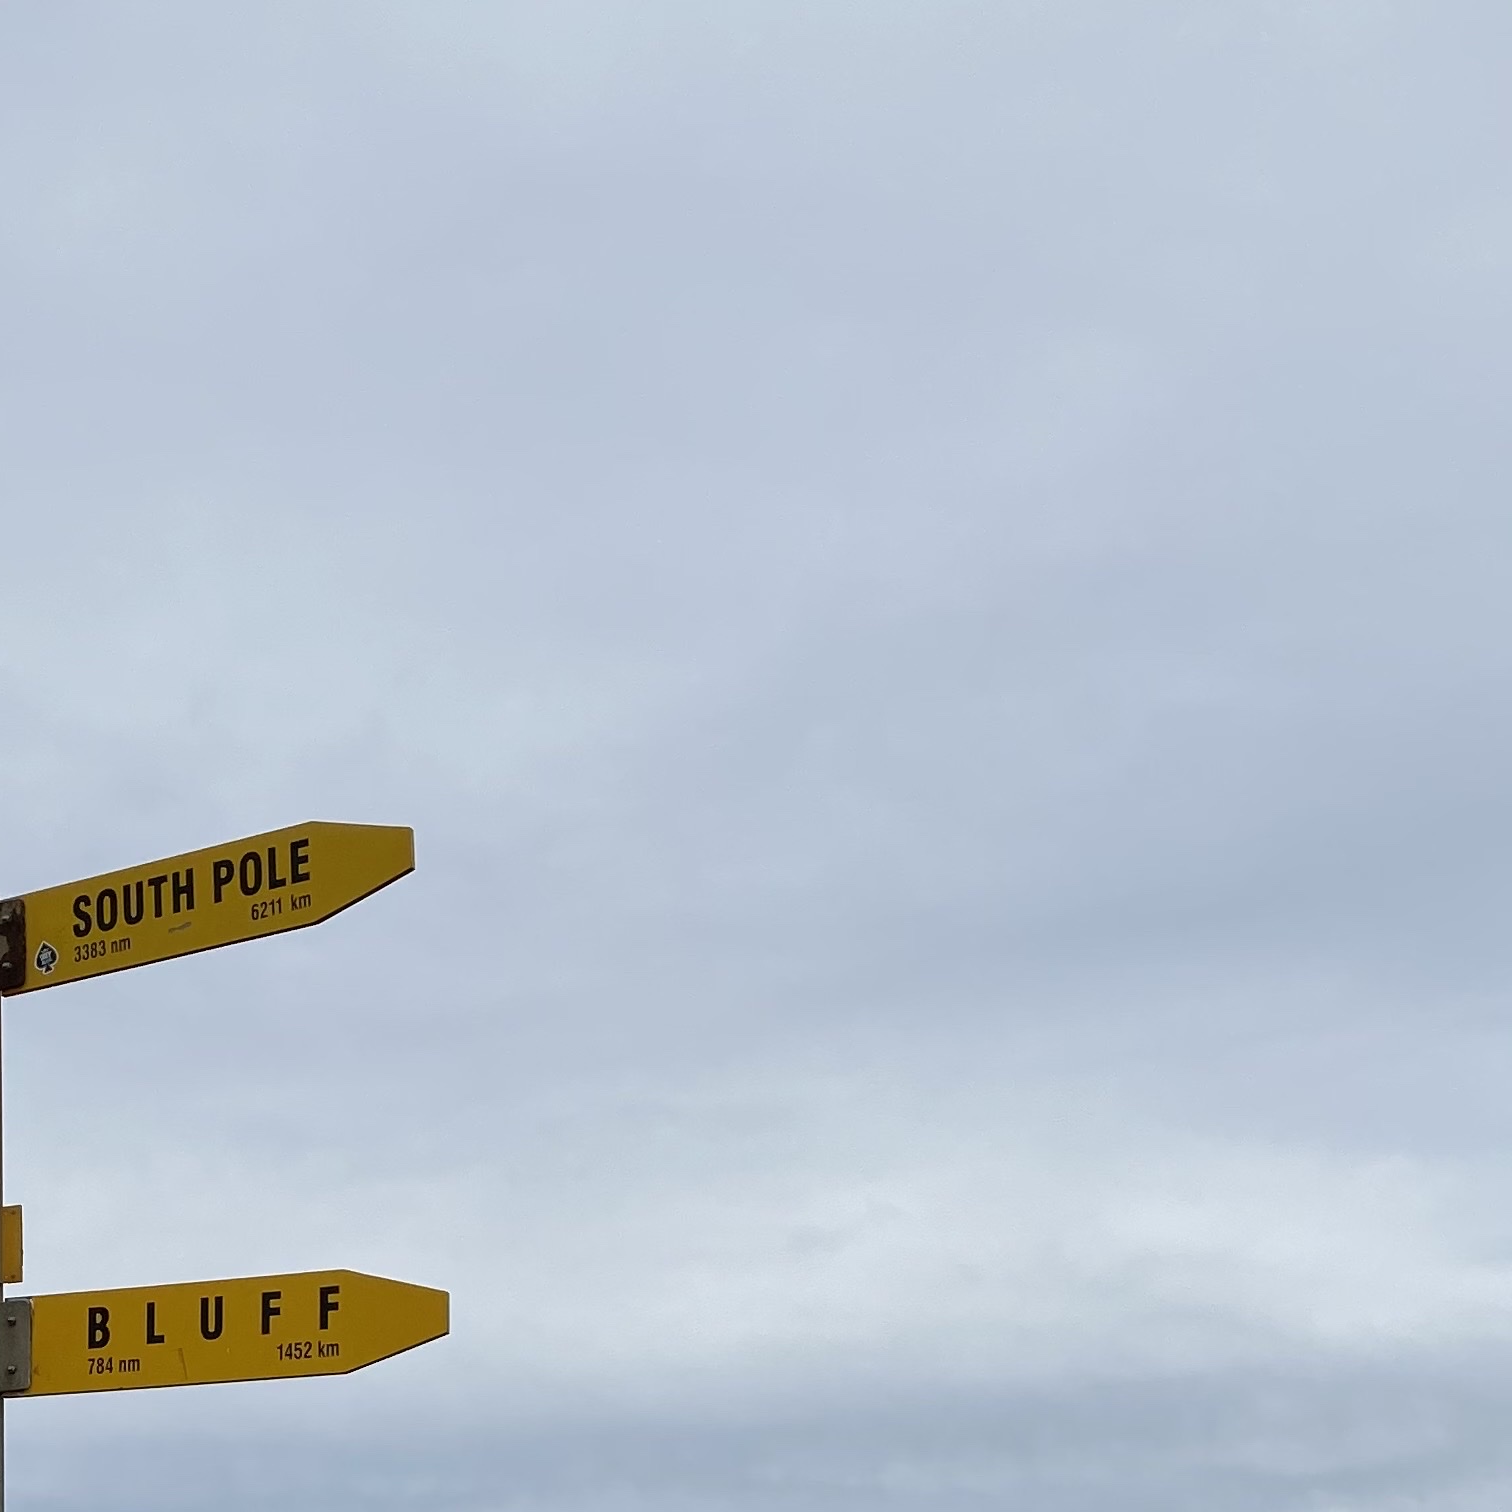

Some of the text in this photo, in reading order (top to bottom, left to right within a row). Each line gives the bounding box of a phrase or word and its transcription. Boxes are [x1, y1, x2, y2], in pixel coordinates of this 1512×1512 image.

[72, 837, 311, 938] SOUTH POLE
[251, 893, 312, 921] 6211 km
[74, 939, 107, 963] 3383
[110, 936, 131, 954] nm
[87, 1284, 340, 1350] BLUFF
[276, 1339, 340, 1361] 1452 km
[87, 1357, 140, 1376] 784 nm
